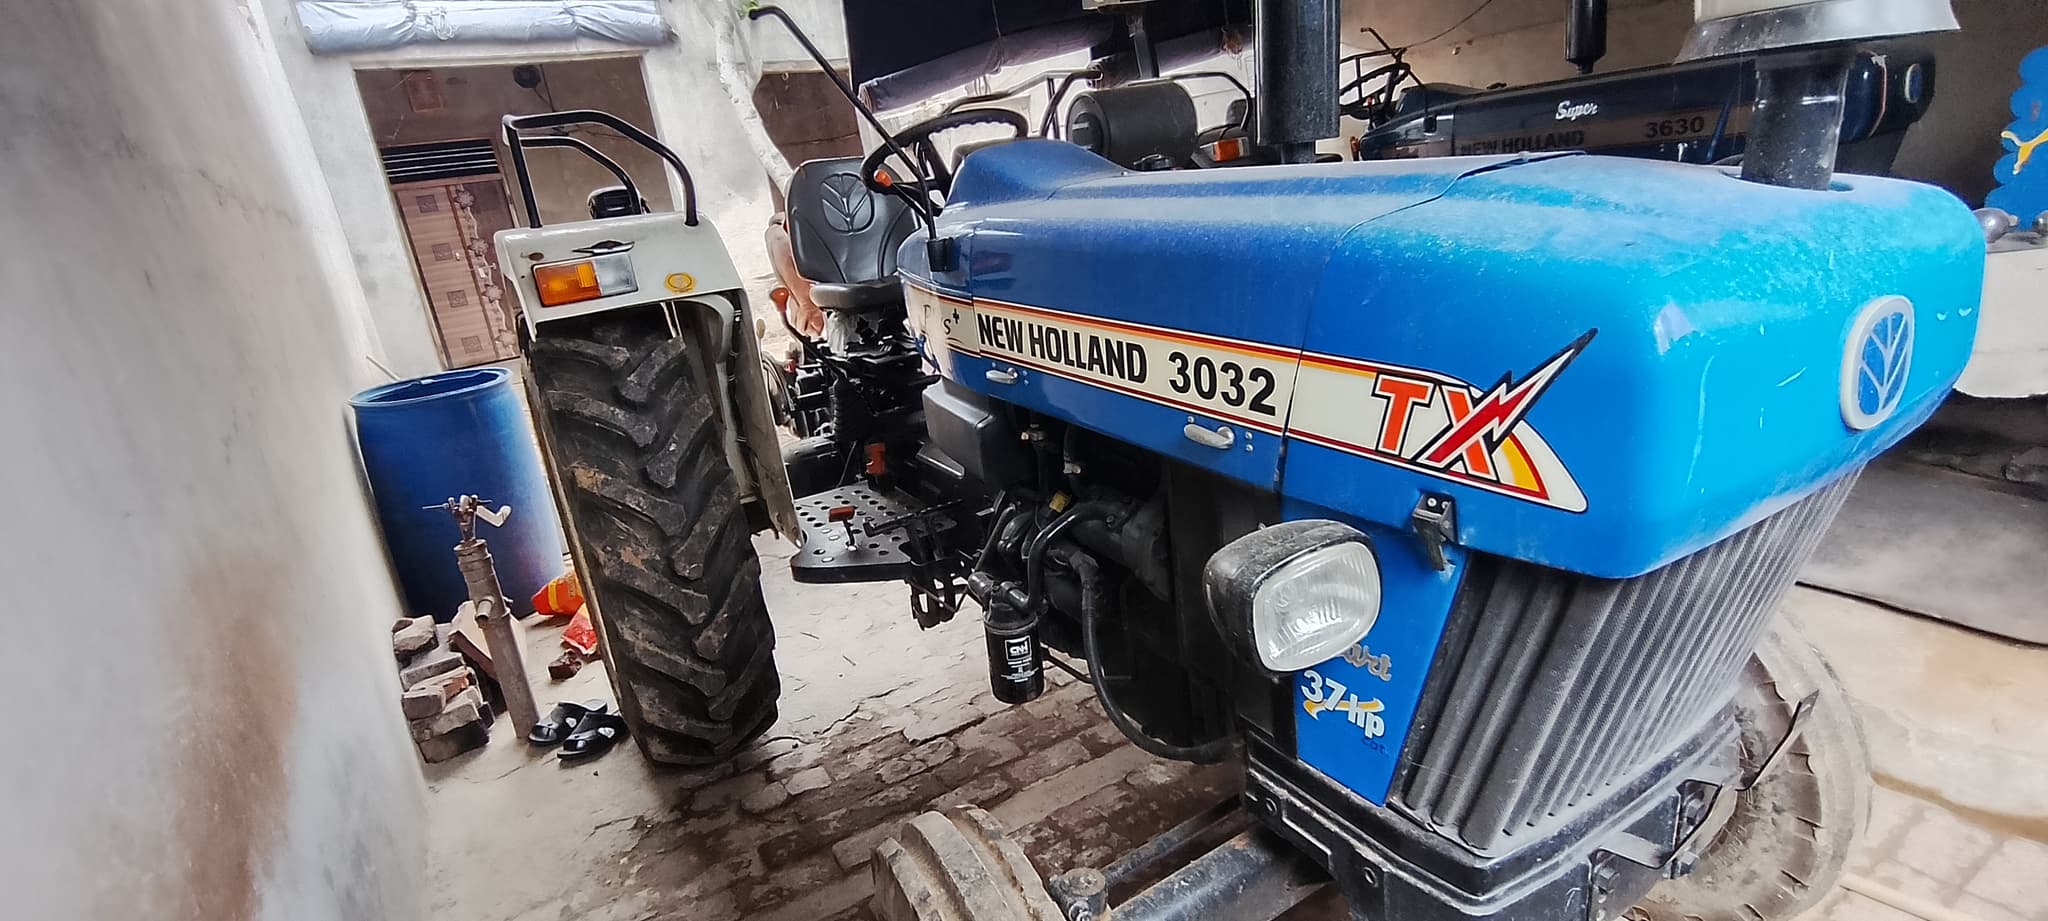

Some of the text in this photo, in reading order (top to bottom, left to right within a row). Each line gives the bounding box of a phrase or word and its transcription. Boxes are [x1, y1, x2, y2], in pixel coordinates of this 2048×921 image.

[1555, 99, 1598, 121] Super
[1458, 117, 1705, 155] NEW HOLLAND 3630
[977, 314, 1560, 483] NEW HOLLAND 3032 TX
